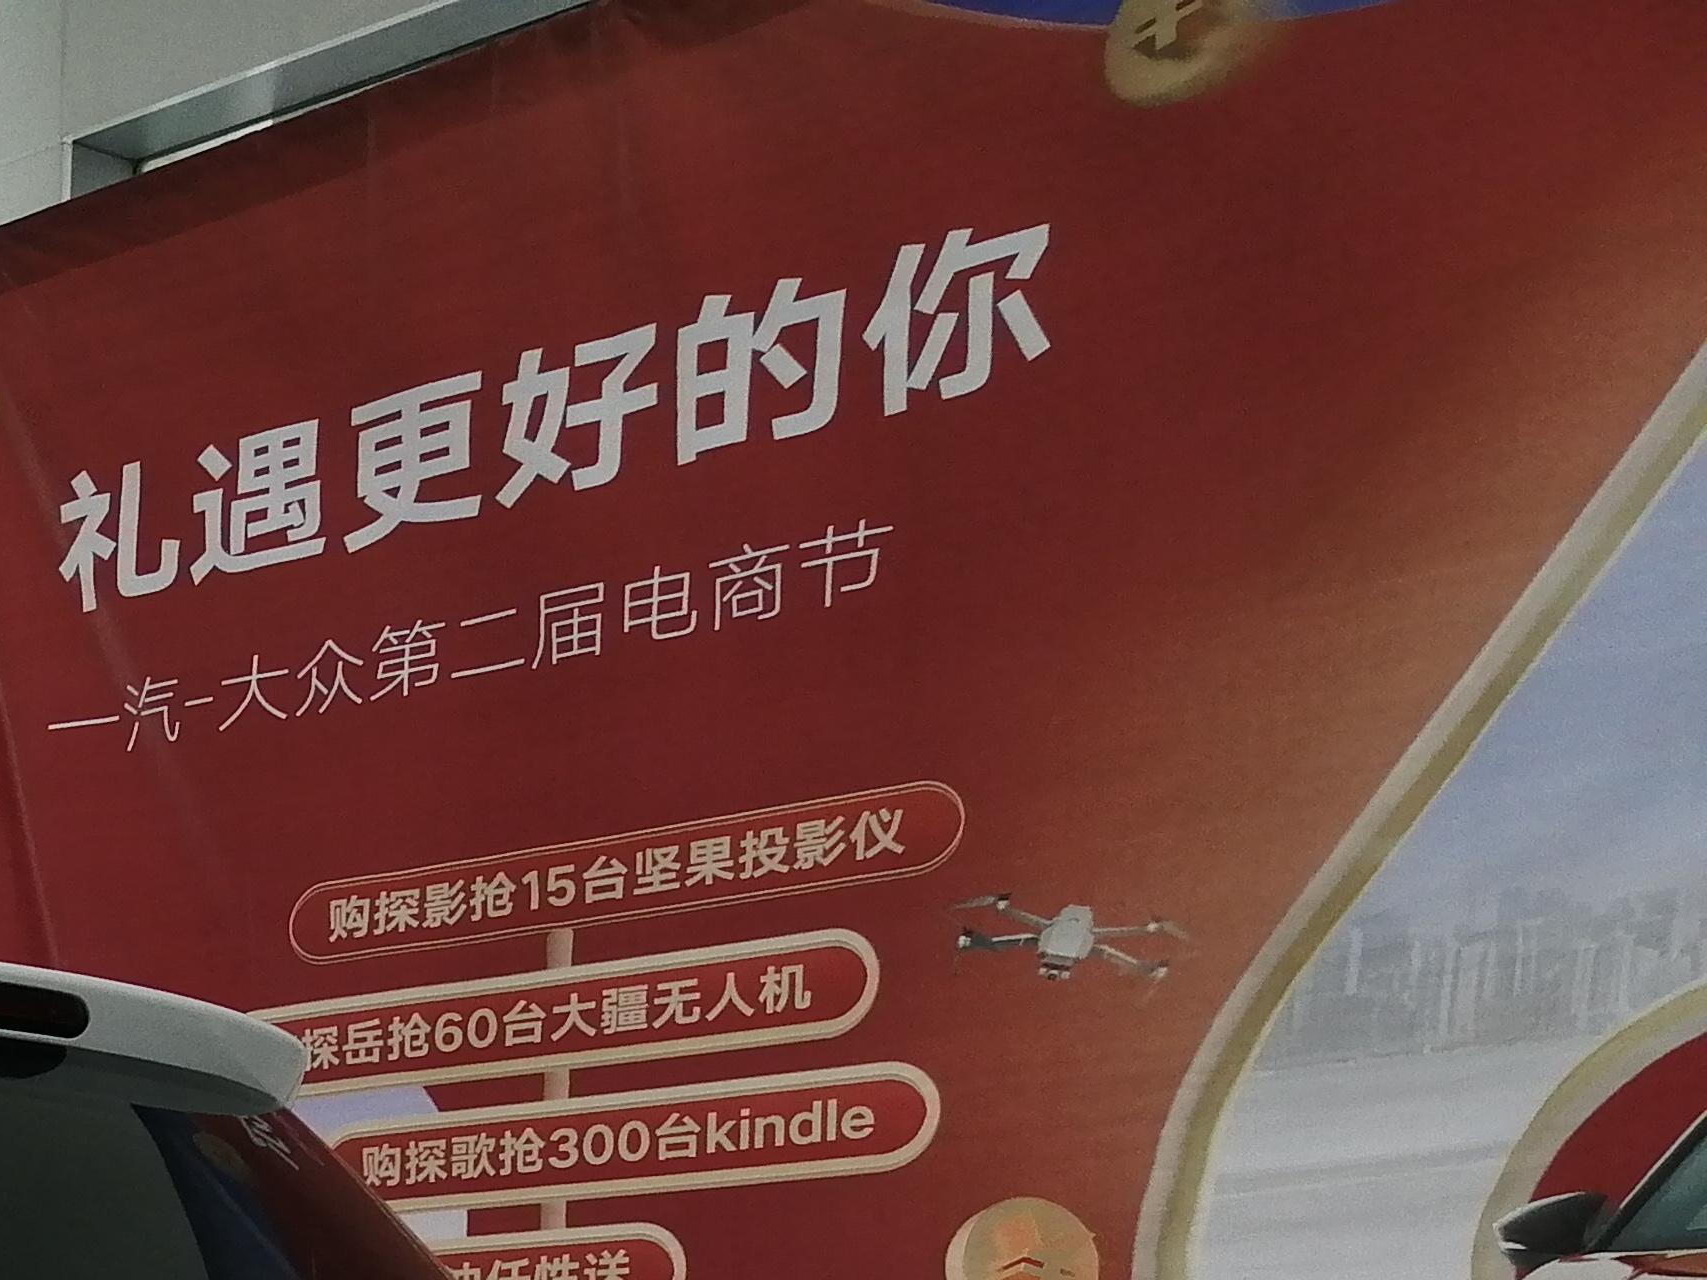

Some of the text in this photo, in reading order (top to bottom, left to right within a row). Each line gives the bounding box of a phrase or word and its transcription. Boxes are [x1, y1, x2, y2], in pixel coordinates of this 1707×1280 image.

[57, 223, 1052, 612] 礼遇更好的你
[46, 516, 895, 754] 一汽-大众第二届电商节
[328, 806, 906, 943] 购探影抢15台坚果投影仪
[295, 963, 811, 1074] 探岳抢60台大疆无人机
[361, 1098, 876, 1189] 购探歌抢300台kindle
